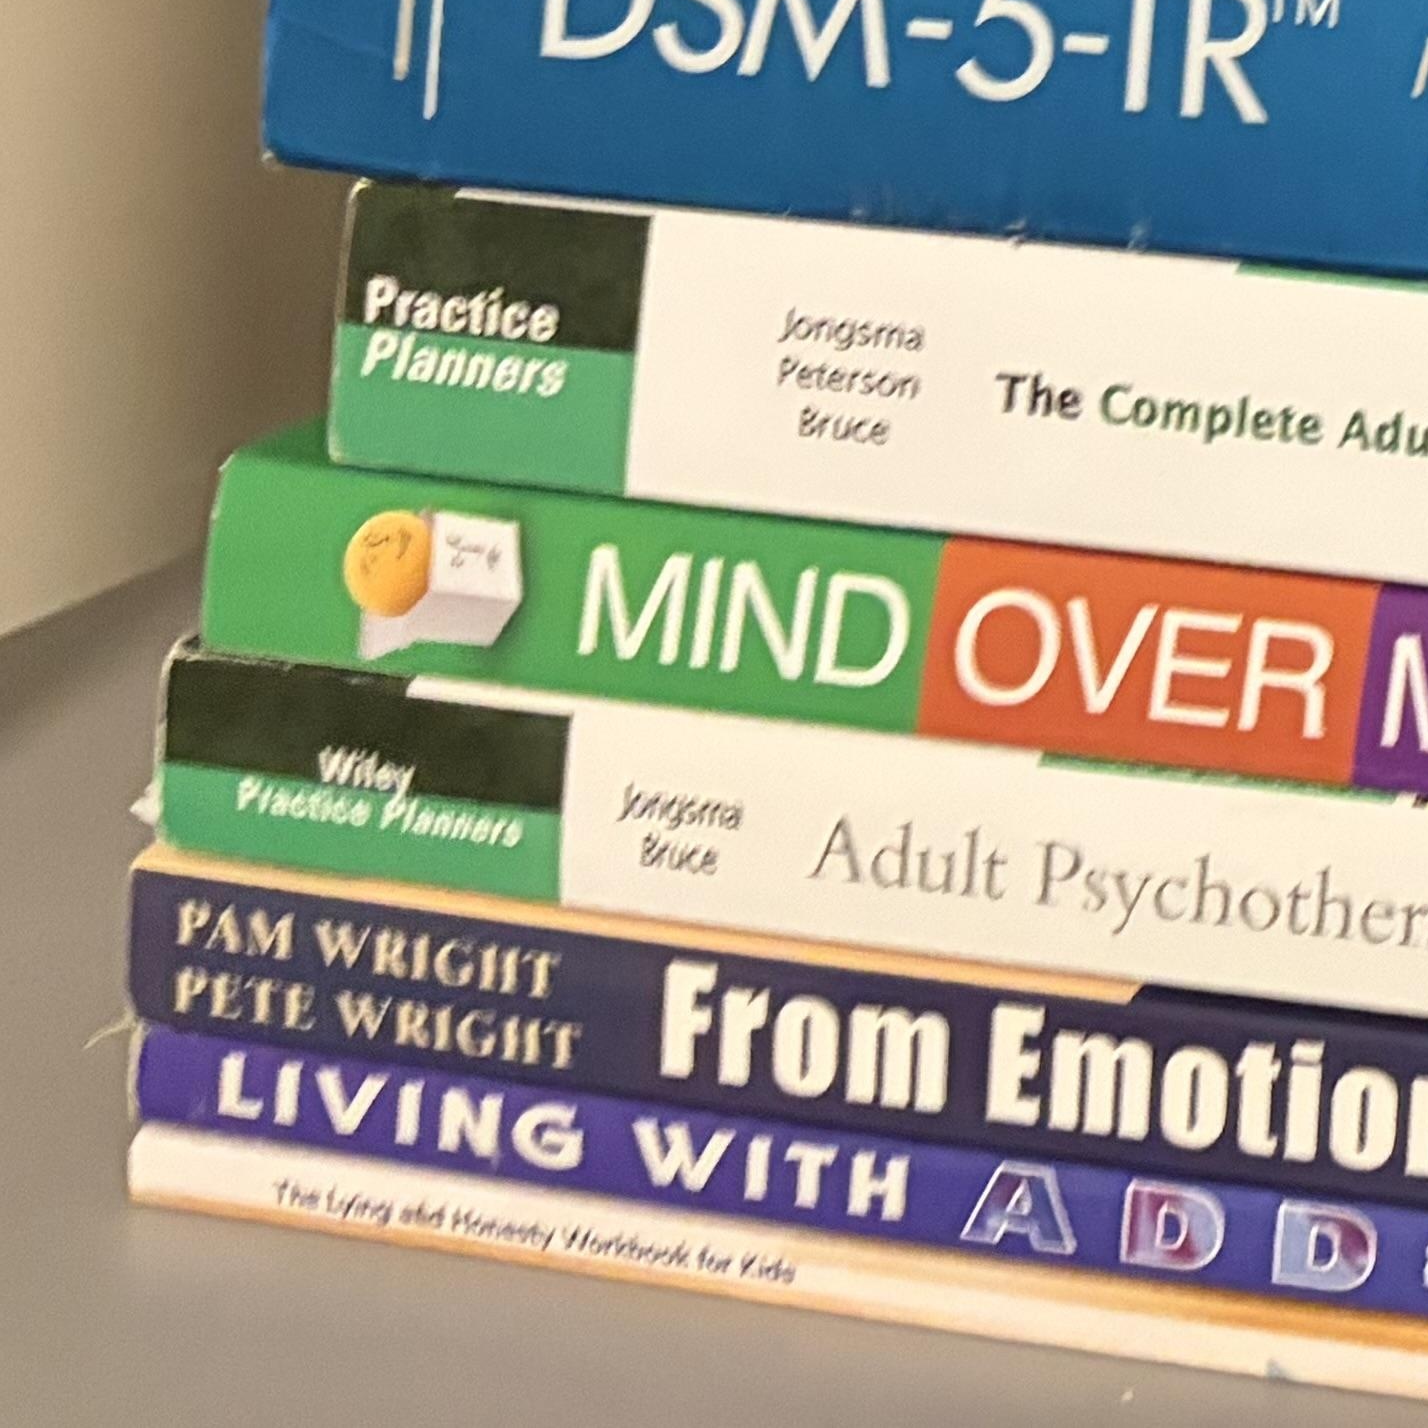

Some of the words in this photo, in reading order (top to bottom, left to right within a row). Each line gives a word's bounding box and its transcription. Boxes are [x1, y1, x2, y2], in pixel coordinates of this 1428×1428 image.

[361, 275, 558, 342] Practice
[776, 307, 926, 354] Jongsma
[360, 330, 569, 398] Planners
[776, 355, 920, 402] Peterson
[798, 408, 892, 446] Bruce
[994, 374, 1082, 421] The
[1099, 382, 1325, 449] Complete
[578, 543, 911, 689] MIND
[953, 587, 1335, 741] OVER
[319, 745, 416, 796] Wiley
[617, 780, 744, 832] Jongsma
[237, 778, 369, 829] Practice
[382, 794, 524, 849] Planners
[638, 831, 719, 875] Bruce
[806, 816, 1008, 902] Adult
[176, 898, 296, 960] PAM
[315, 919, 562, 1000] WRIGHT
[173, 967, 315, 1031] PETE
[334, 988, 581, 1070] WRIGHT
[658, 959, 949, 1115] From
[216, 1048, 585, 1172] LIVING
[633, 1115, 912, 1221] WITH
[273, 1178, 320, 1209] The
[326, 1183, 392, 1227] Lying
[400, 1200, 447, 1228] and
[563, 1224, 691, 1267] Workbook
[697, 1244, 732, 1274] for
[739, 1251, 797, 1284] Kids
